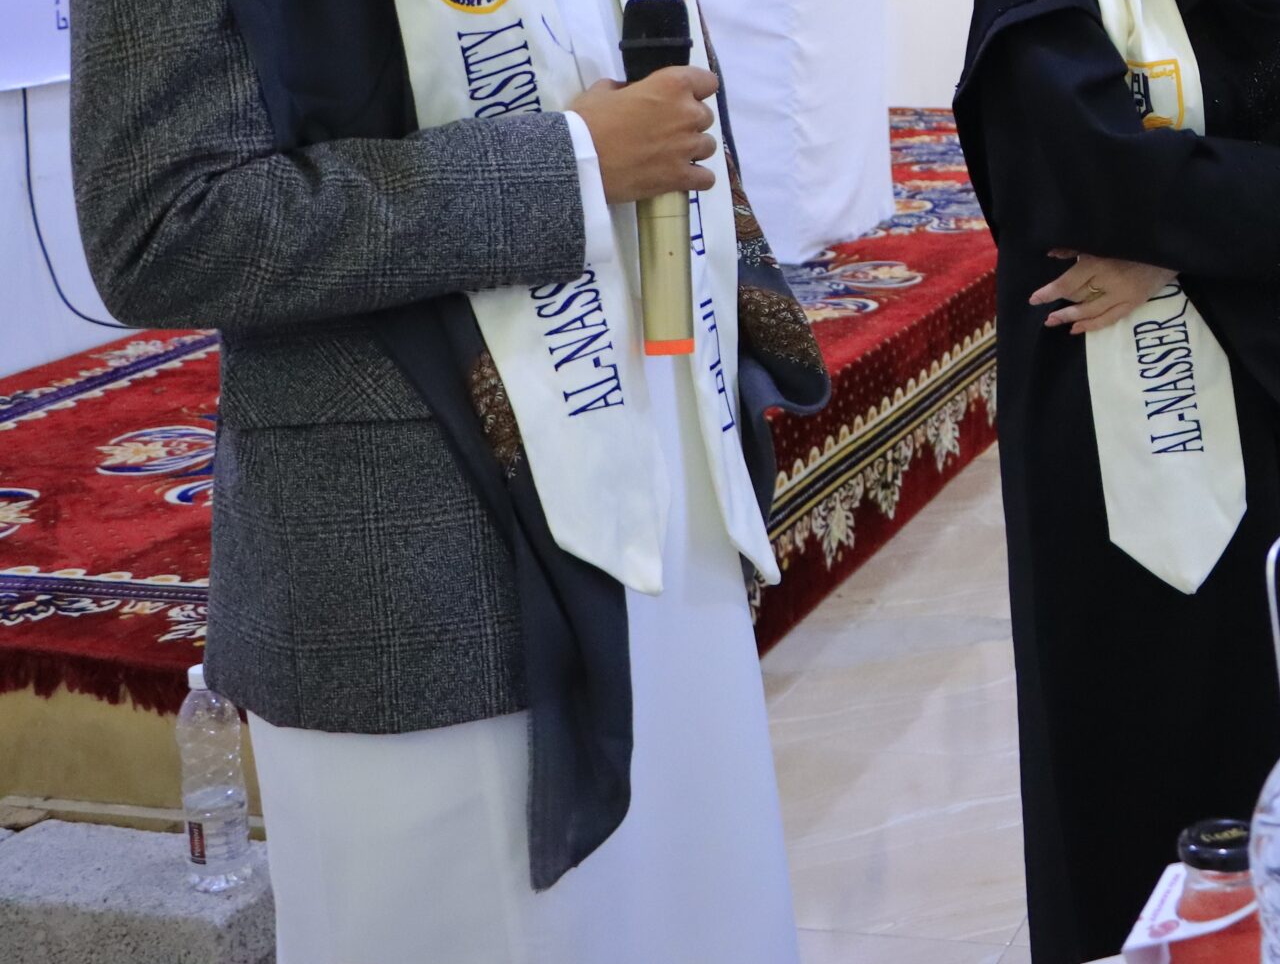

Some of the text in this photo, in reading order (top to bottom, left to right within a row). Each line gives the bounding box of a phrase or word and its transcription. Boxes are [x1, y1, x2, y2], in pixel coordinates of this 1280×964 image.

[457, 18, 625, 417] AL-NASS RSITY
[1134, 298, 1204, 455] AL-NASSER
